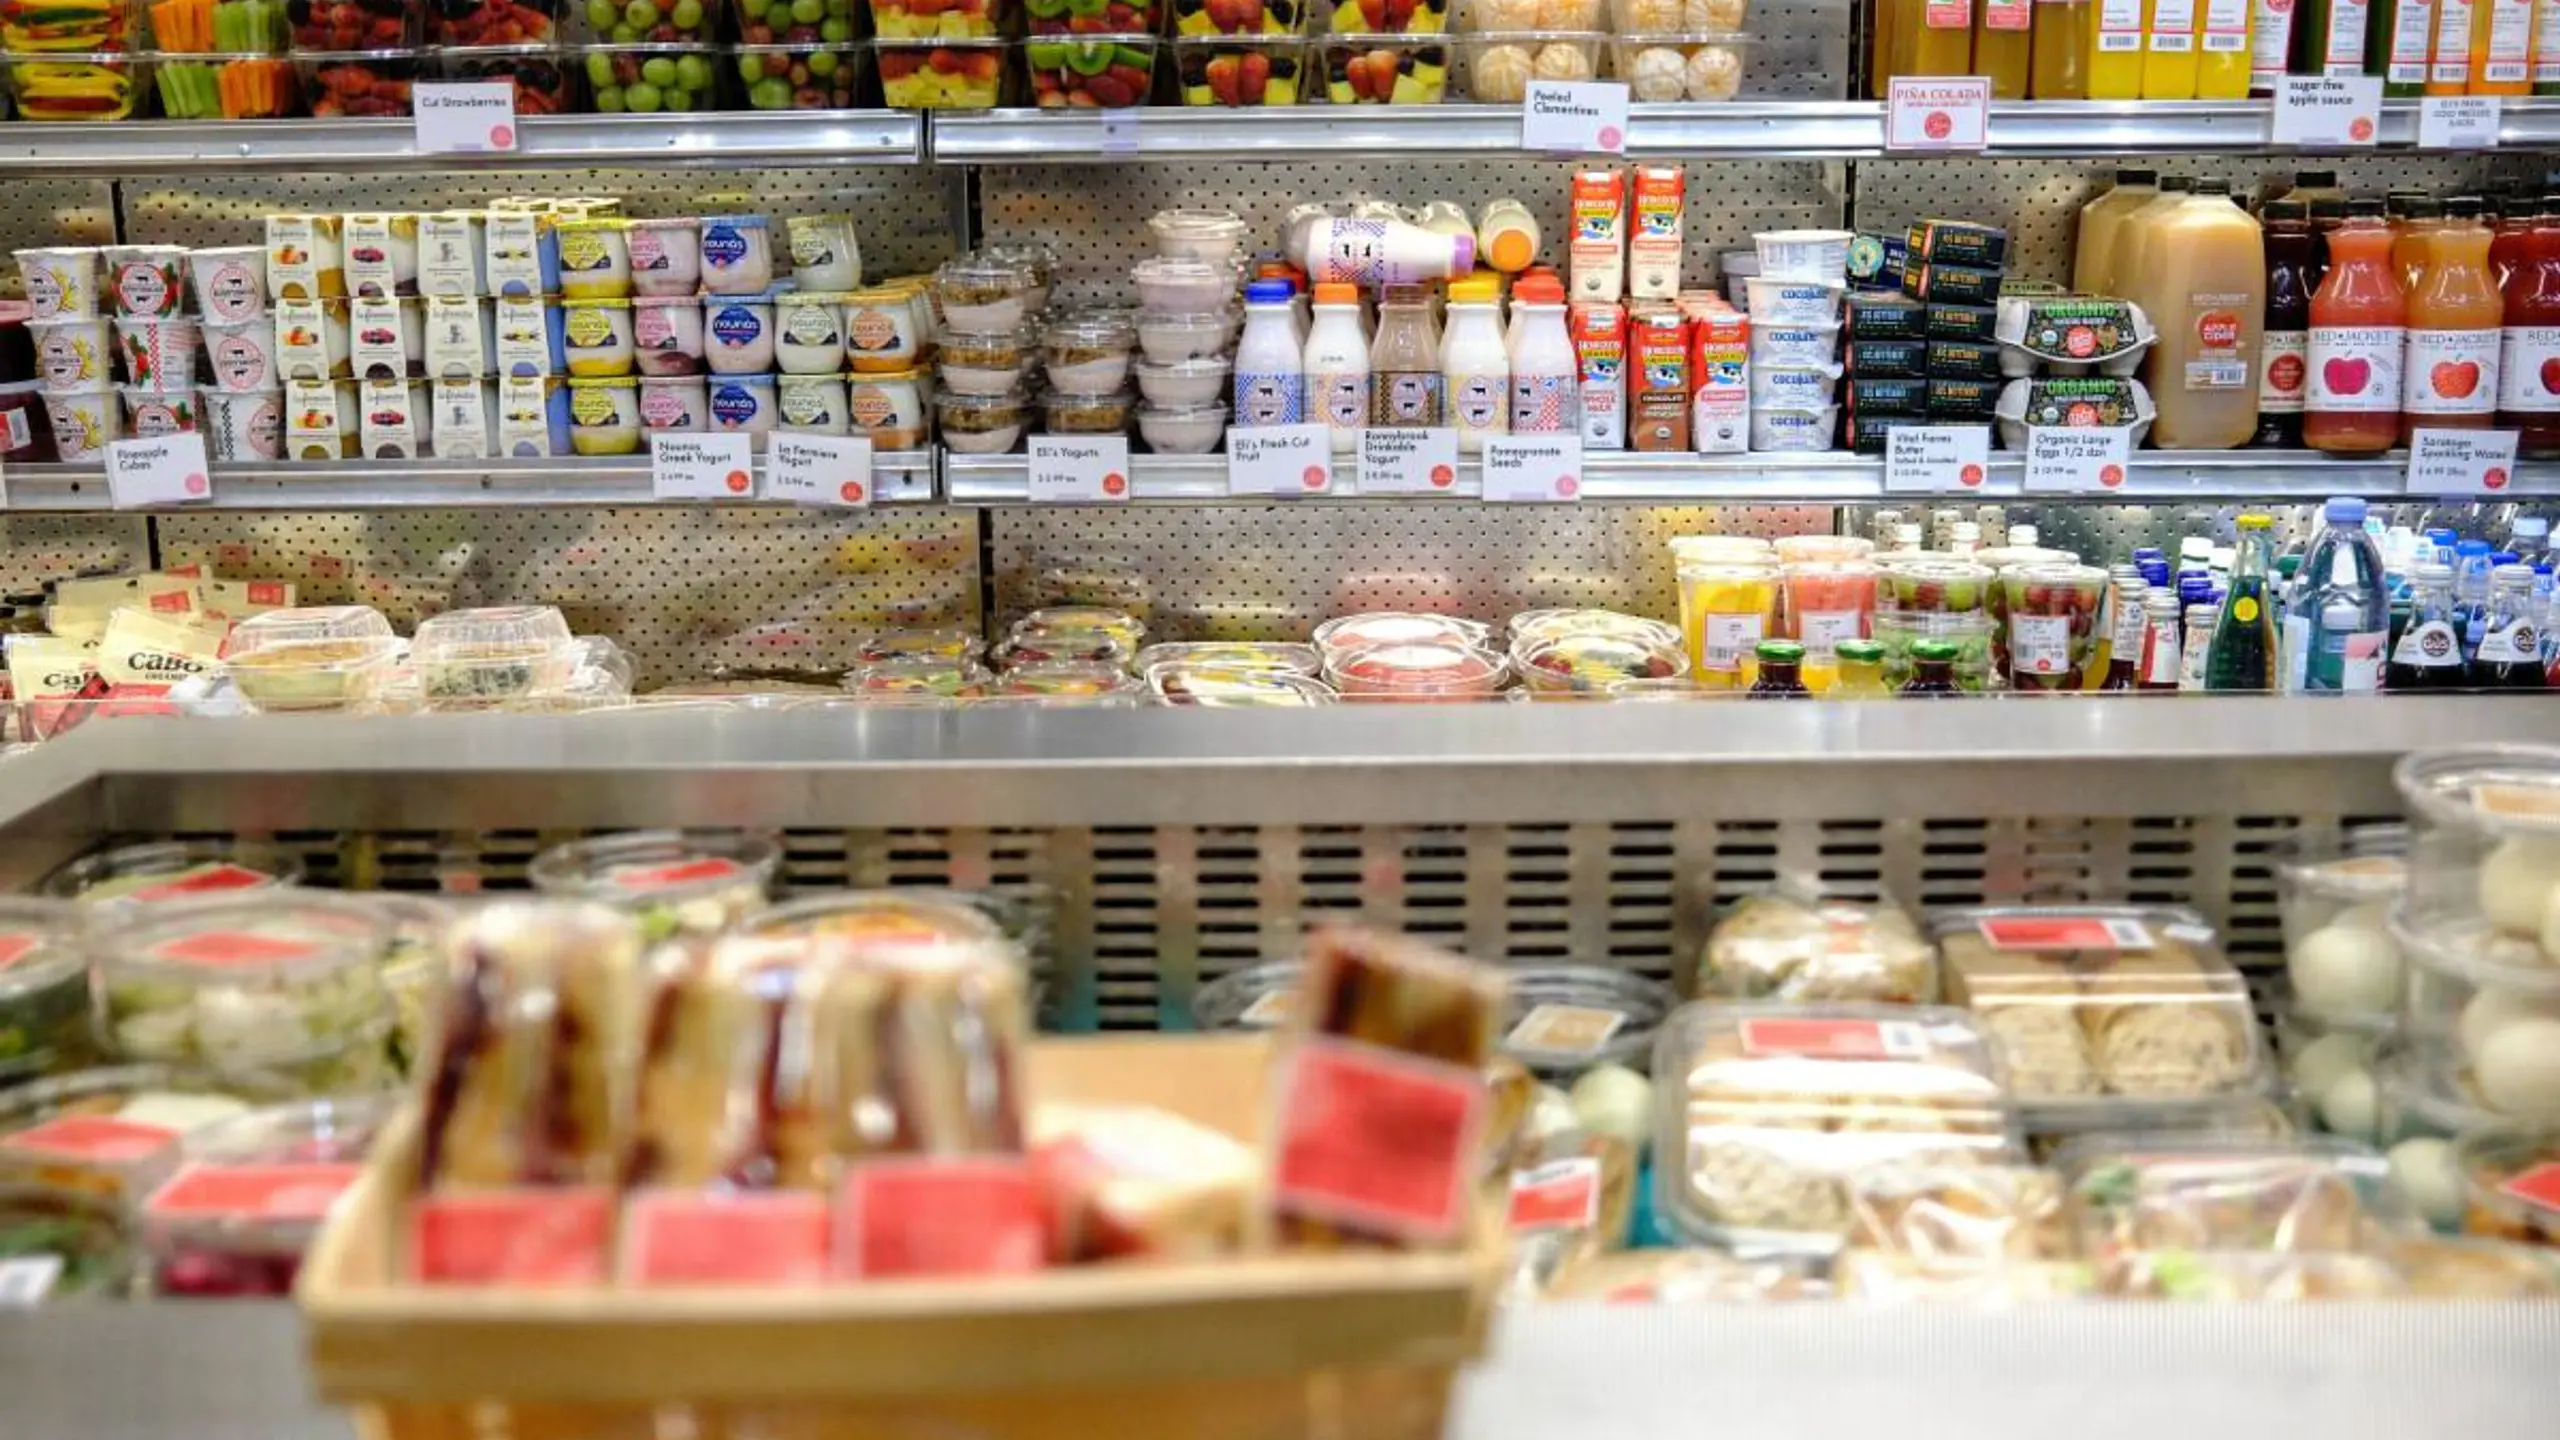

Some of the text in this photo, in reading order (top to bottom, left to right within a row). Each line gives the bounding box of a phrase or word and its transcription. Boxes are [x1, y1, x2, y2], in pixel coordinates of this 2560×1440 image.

[2289, 79, 2345, 93] sugar free
[1534, 90, 1571, 102] Peeled
[1896, 87, 1982, 99] PIÑA COLADA
[422, 96, 507, 107] Cut Strawberries
[2288, 96, 2354, 107] apple sauce
[1534, 102, 1599, 116] Clementines
[2047, 380, 2117, 395] ORGANIC
[1366, 430, 1428, 440] Ronnybrook
[1896, 432, 1951, 443] Vital Farms
[2037, 434, 2111, 446] Organic Large
[1235, 438, 1257, 450] Eli's
[1366, 441, 1416, 451] Drinkable
[117, 445, 168, 460] Pineapple
[1060, 447, 1099, 458] Yogurts
[1491, 445, 1561, 459] Pomegranate
[1895, 446, 1924, 454] Butter
[2035, 447, 2107, 458] Eggs 1/2 dzn
[2475, 449, 2507, 459] Water
[660, 452, 731, 465] Greek Yogurt
[779, 455, 812, 467] Yogurt
[1236, 452, 1260, 461] Fruit
[1366, 454, 1400, 465] Yogurt
[1491, 457, 1522, 467] Seeds
